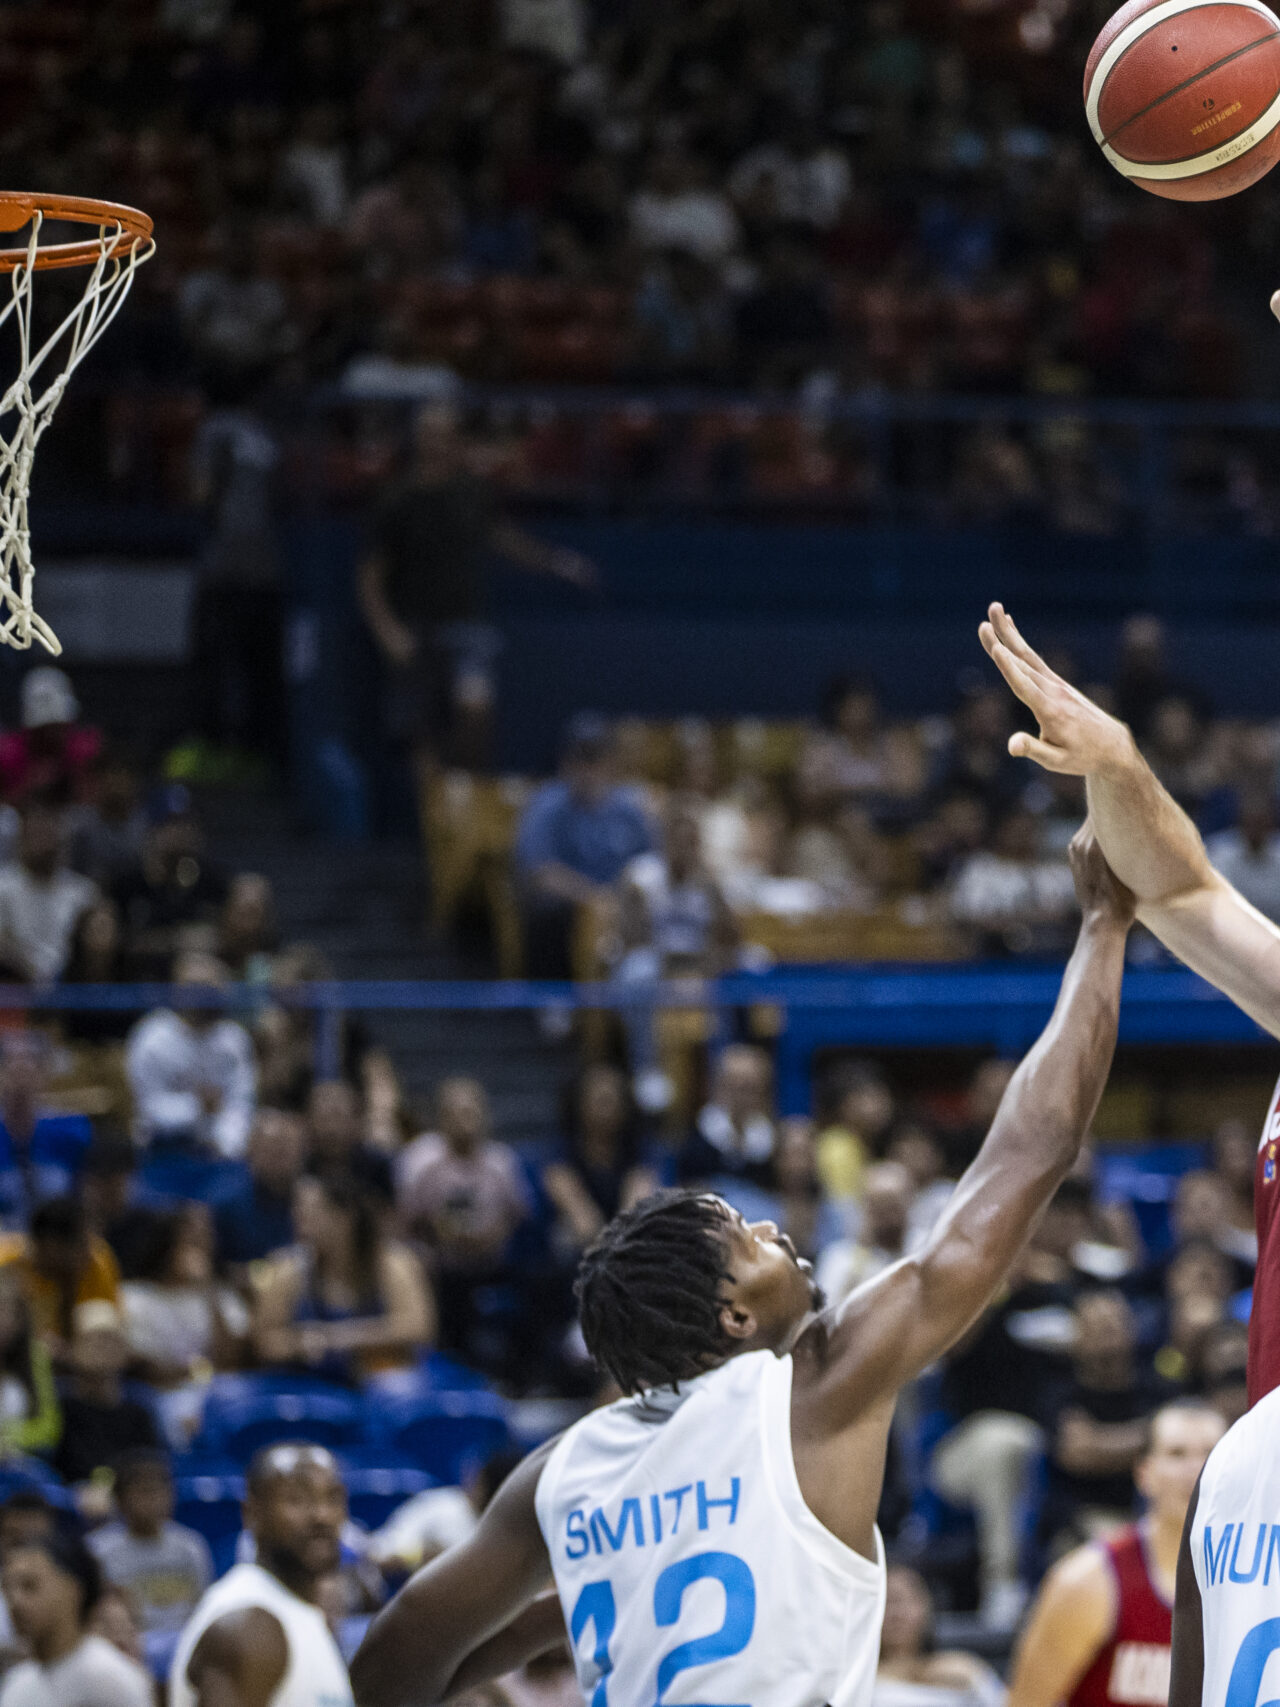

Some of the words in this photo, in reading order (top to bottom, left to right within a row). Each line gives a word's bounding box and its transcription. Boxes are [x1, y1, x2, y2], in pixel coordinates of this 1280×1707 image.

[1192, 100, 1242, 136] COMPETITION
[565, 1477, 741, 1560] SMITH
[571, 1551, 756, 1707] 12
